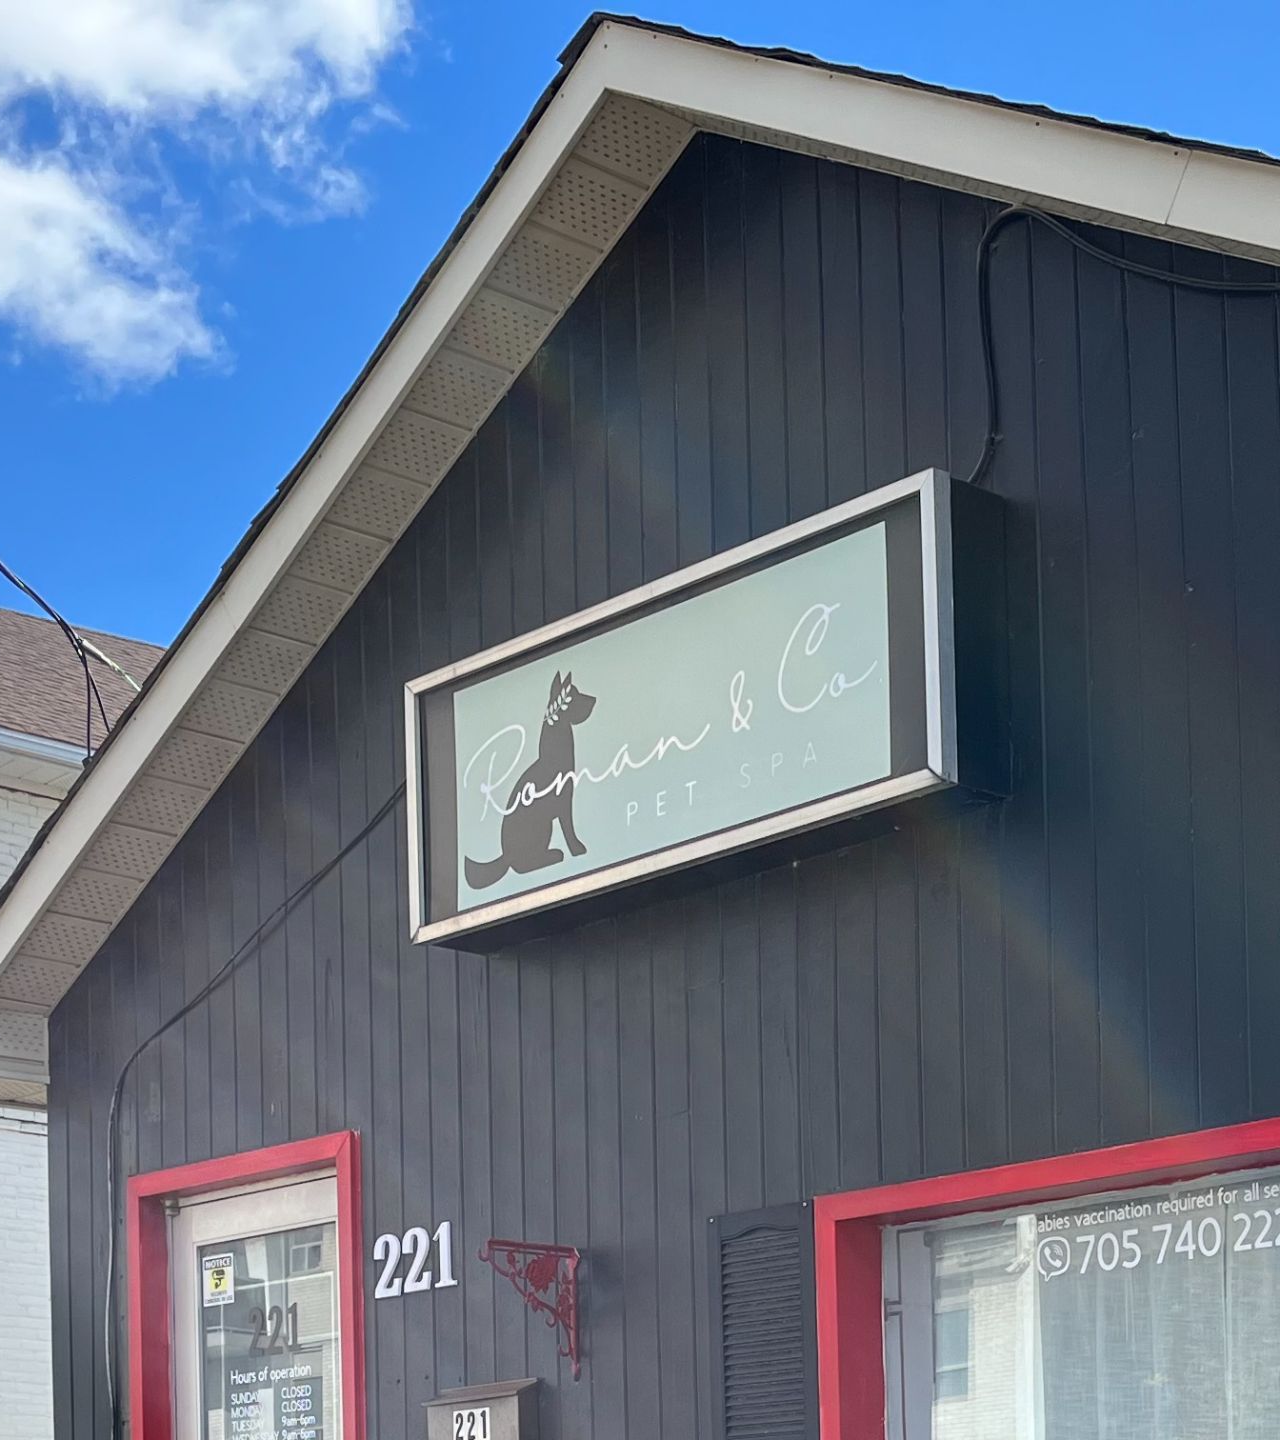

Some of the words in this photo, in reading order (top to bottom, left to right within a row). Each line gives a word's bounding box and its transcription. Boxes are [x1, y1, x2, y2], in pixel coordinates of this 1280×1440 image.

[464, 722, 711, 822] Roman
[730, 671, 753, 733] &
[626, 780, 699, 826] PET
[740, 742, 818, 788] SPA
[1032, 1210, 1070, 1233] abies
[1074, 1198, 1152, 1227] vaccination
[1156, 1189, 1214, 1216] required
[1217, 1187, 1238, 1204] for
[1243, 1183, 1261, 1202] all
[205, 1257, 231, 1269] NOTICE
[373, 1221, 458, 1300] 221
[1076, 1228, 1142, 1275] 705
[1152, 1216, 1222, 1265] 740
[248, 1302, 303, 1358] 221
[230, 1369, 257, 1385] Hours
[258, 1366, 269, 1382] of
[269, 1363, 312, 1383] operation
[230, 1391, 261, 1405] SUNDAY
[281, 1385, 312, 1399] CLOSED
[231, 1405, 264, 1419] MONDAY
[281, 1399, 312, 1413] CLOSED
[232, 1420, 264, 1433] TUESDAY
[281, 1413, 316, 1427] 9am-6pm
[282, 1427, 316, 1440] 9am-6pm
